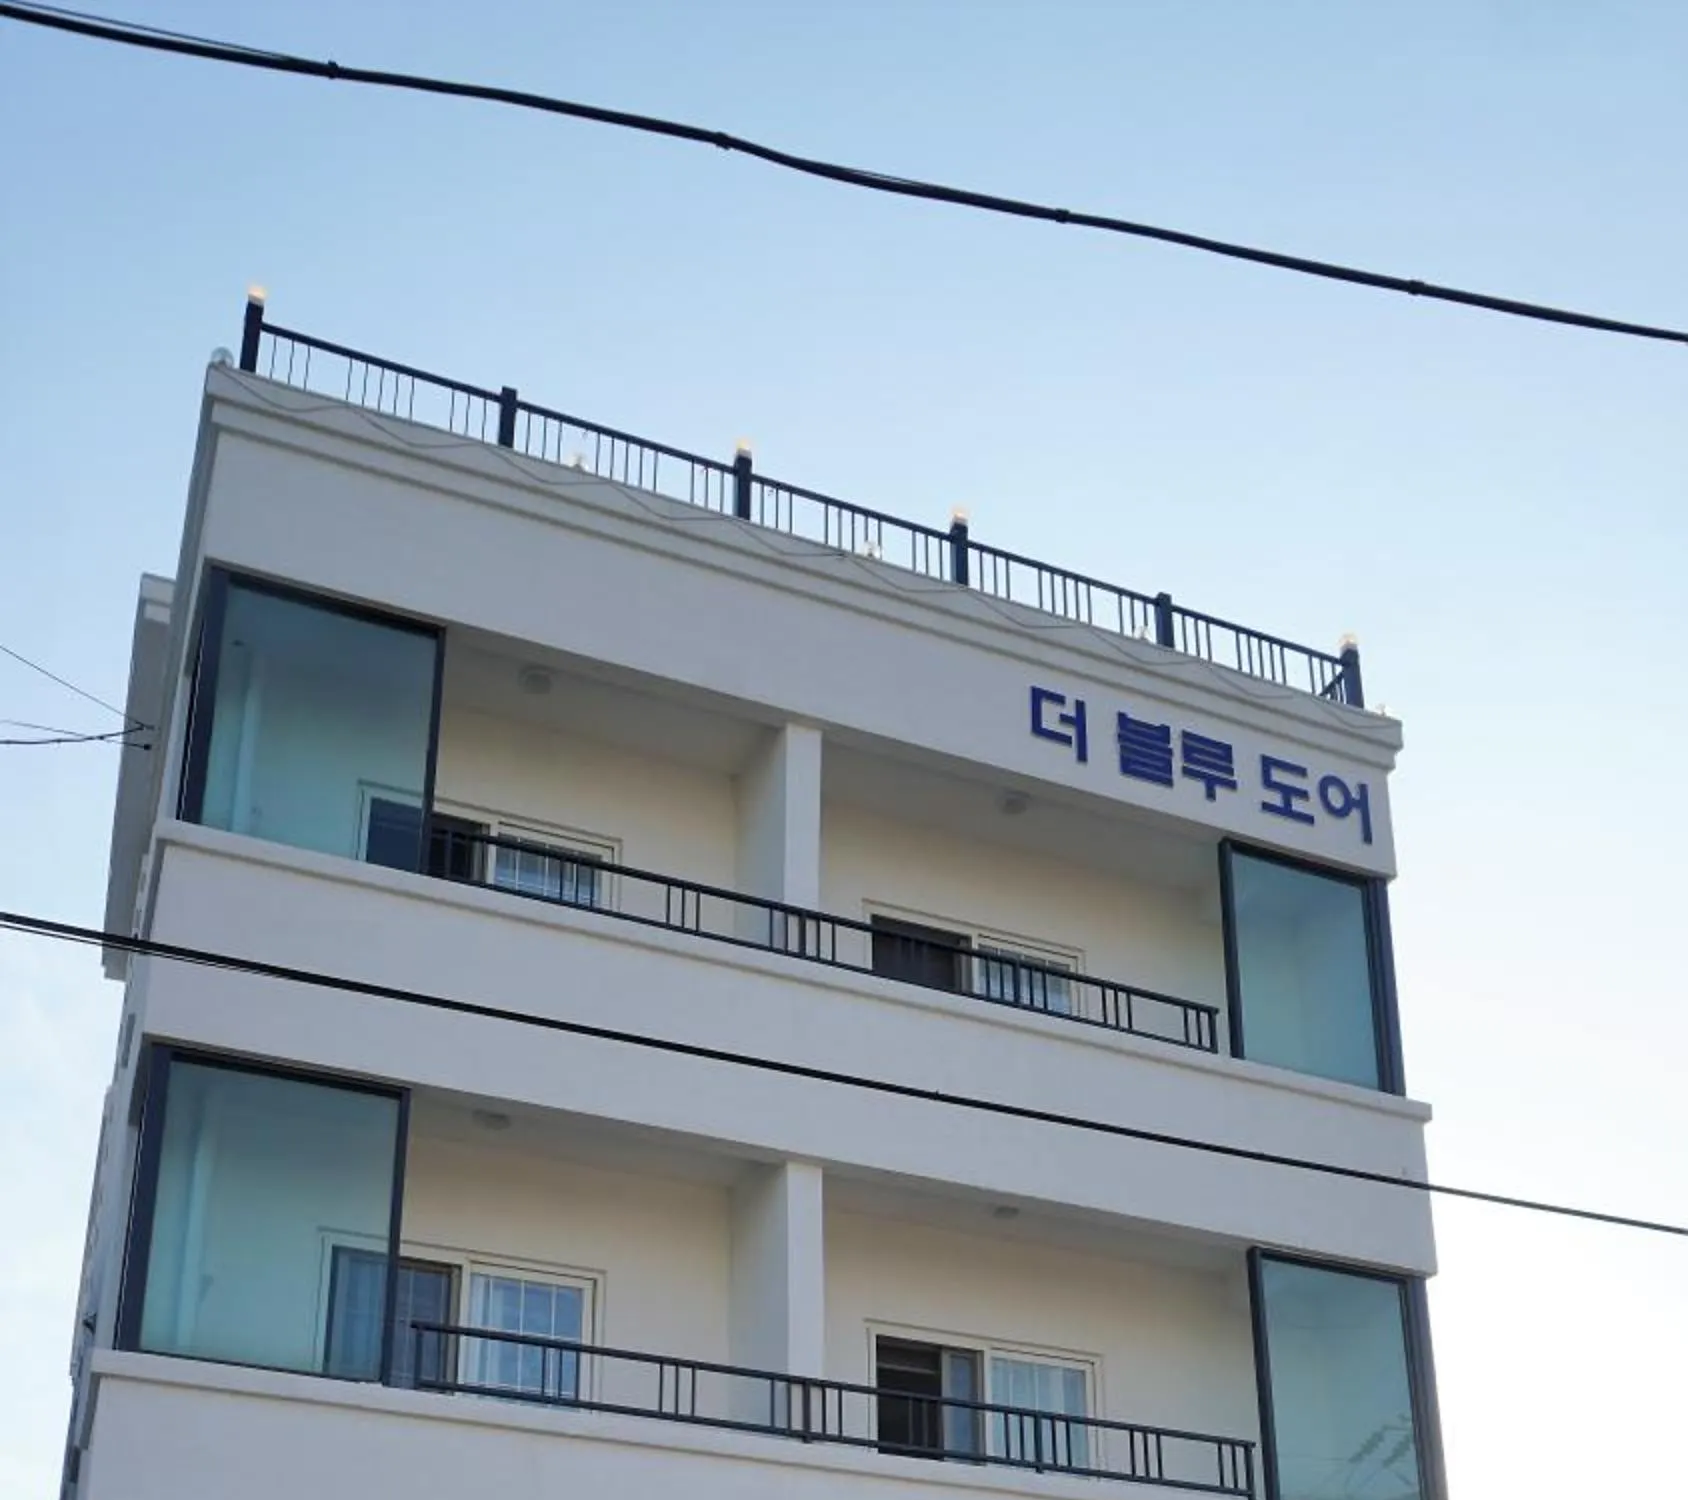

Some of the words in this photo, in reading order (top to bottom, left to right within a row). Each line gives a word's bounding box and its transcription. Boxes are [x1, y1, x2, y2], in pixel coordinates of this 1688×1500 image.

[1030, 685, 1088, 763] 더
[1117, 711, 1238, 801] 블루
[1260, 753, 1373, 845] 도어
